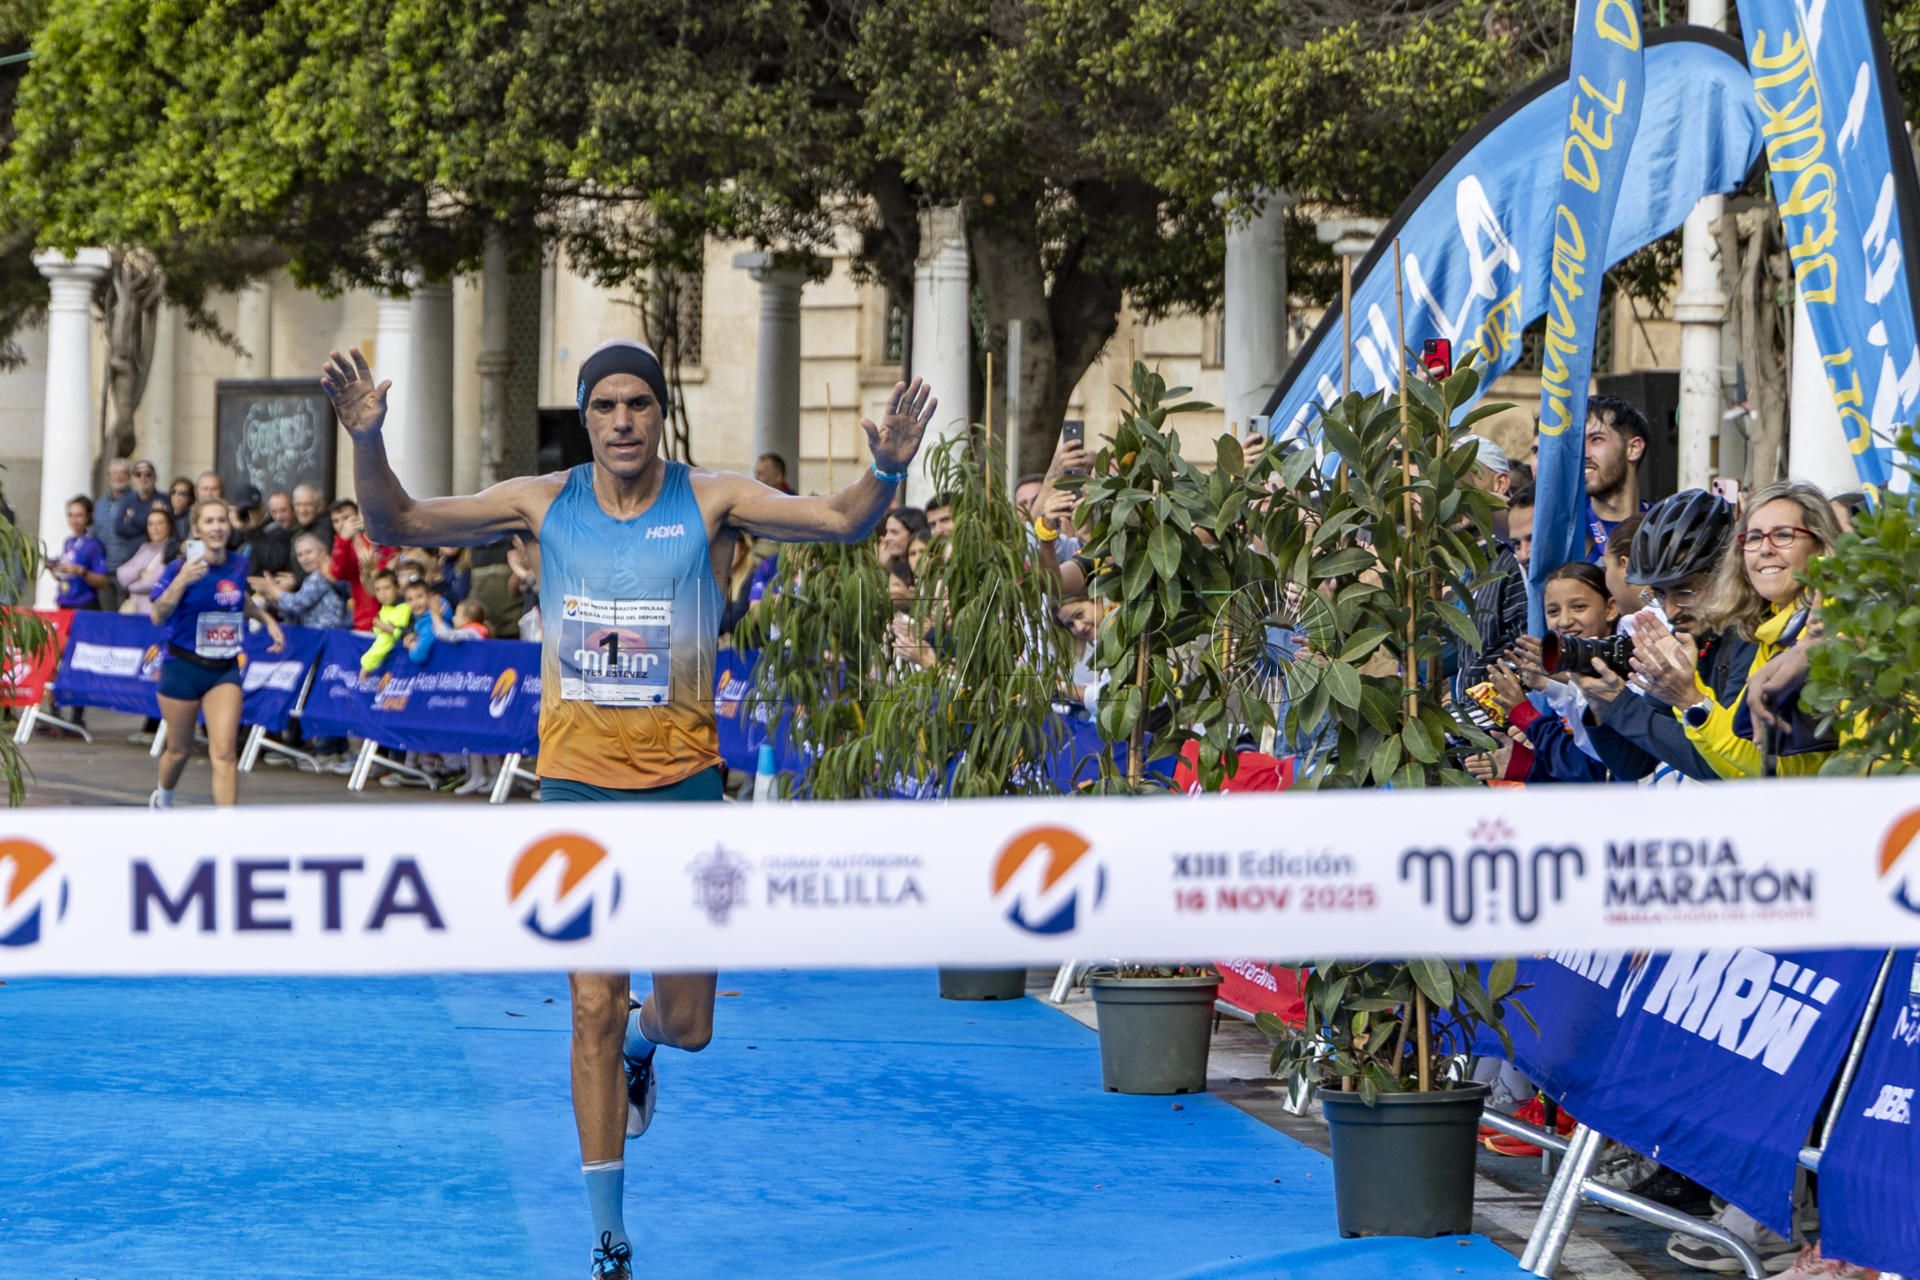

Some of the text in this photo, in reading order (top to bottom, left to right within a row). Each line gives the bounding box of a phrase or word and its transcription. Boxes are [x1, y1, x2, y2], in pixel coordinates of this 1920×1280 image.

[1563, 74, 1627, 194] DEL
[645, 523, 685, 540] HOKA
[599, 631, 619, 665] 1
[415, 671, 438, 691] Hotel
[521, 674, 541, 693] Hote
[1172, 847, 1353, 878] XIII Edición
[1604, 837, 1738, 869] MEDIA
[130, 857, 447, 933] META
[766, 871, 926, 907] MELILLA
[1217, 885, 1291, 912] NOV
[1300, 883, 1378, 911] 2025
[1604, 862, 1814, 907] MARATÓN
[1642, 947, 1840, 1076] MRW
